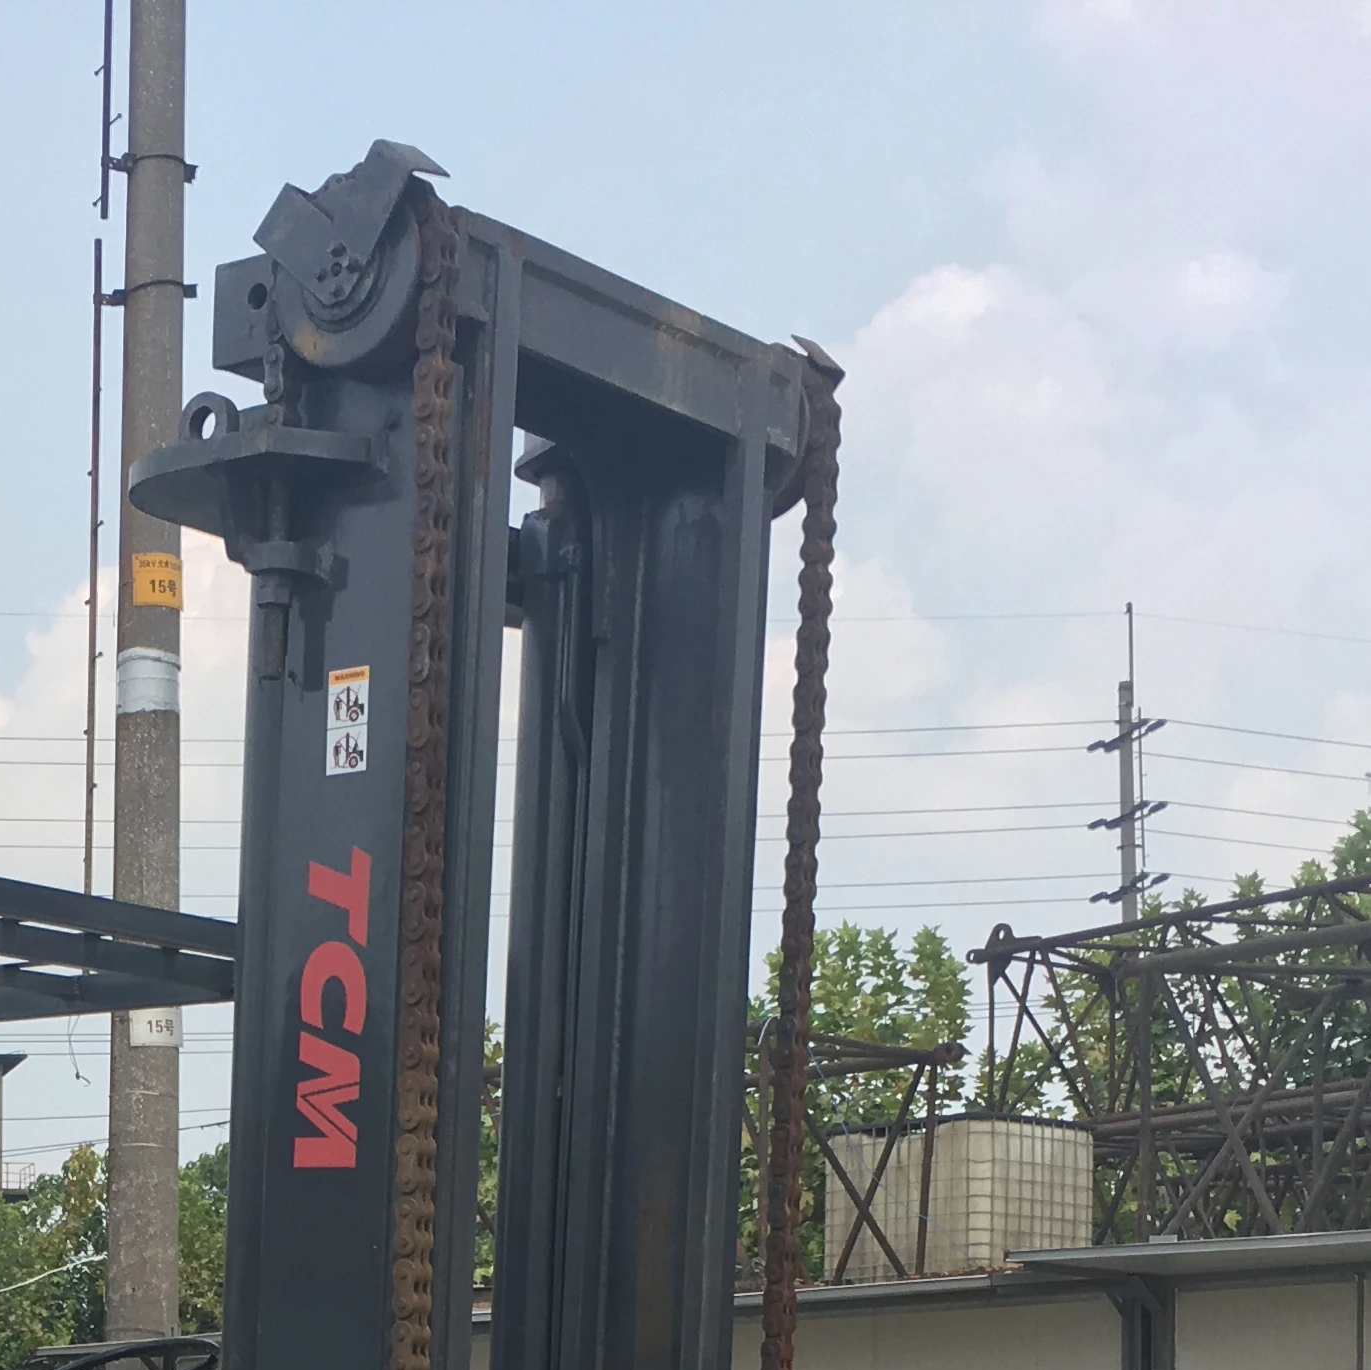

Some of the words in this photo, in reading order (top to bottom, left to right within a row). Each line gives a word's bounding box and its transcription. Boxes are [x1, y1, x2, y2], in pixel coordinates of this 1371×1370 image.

[149, 579, 177, 598] 15号
[293, 847, 371, 1168] TCM
[146, 1018, 175, 1037] 15号
